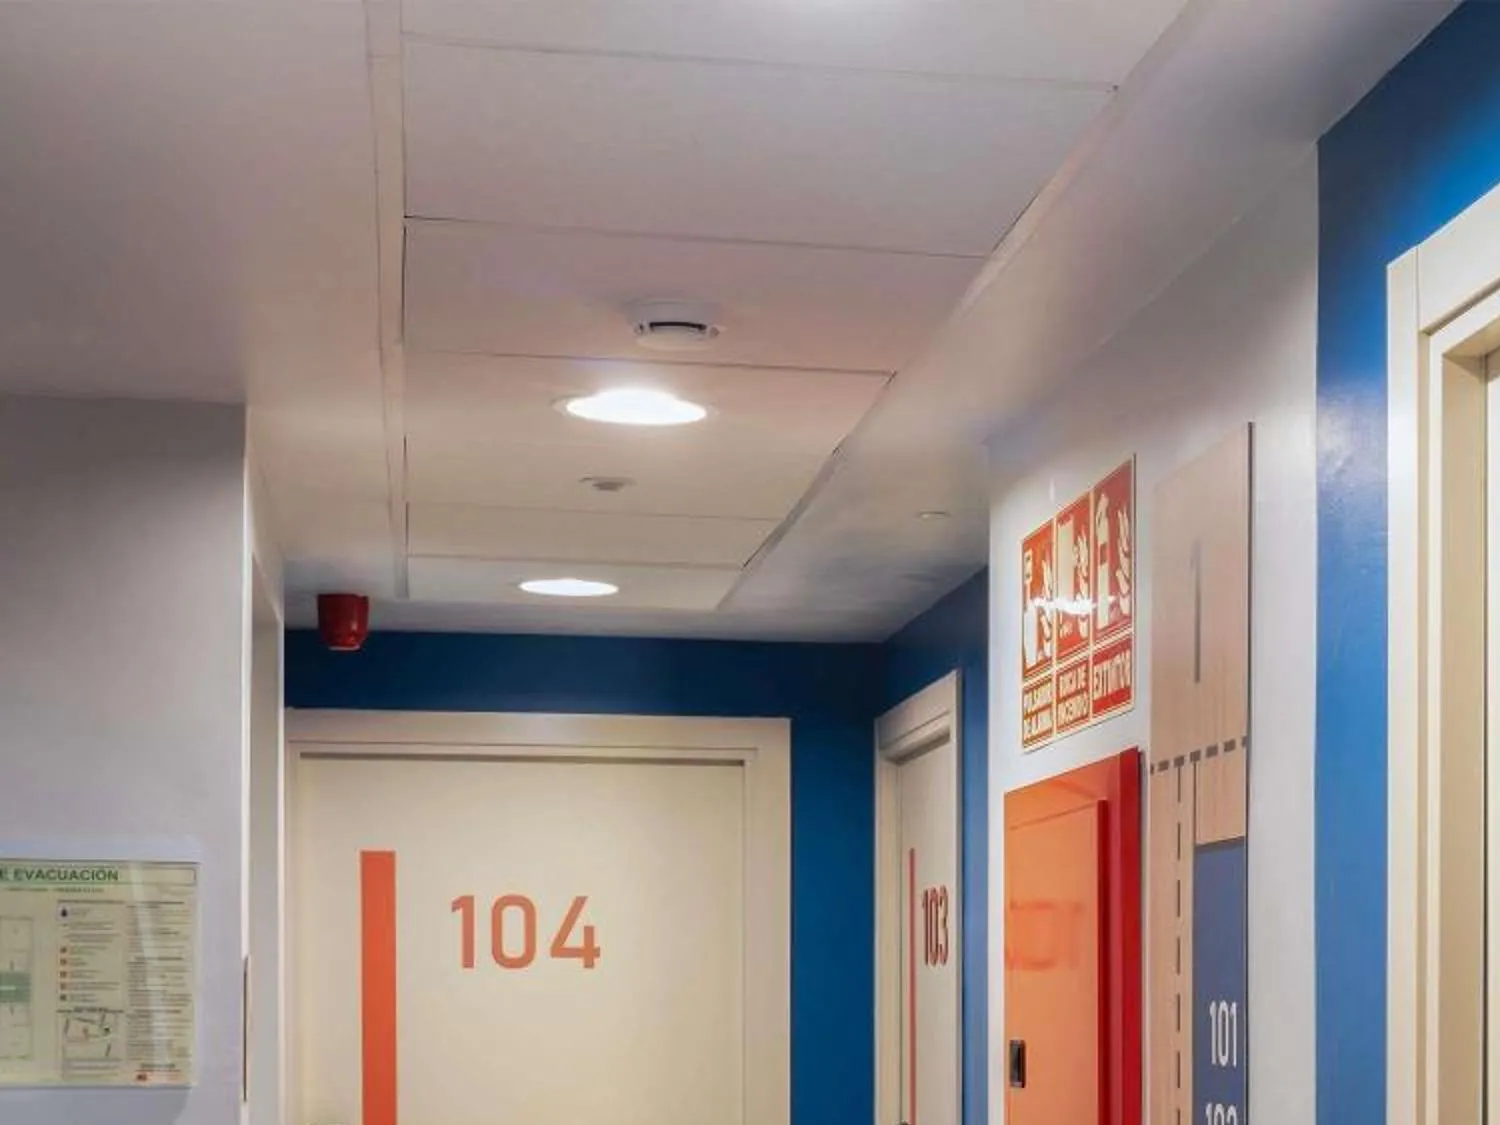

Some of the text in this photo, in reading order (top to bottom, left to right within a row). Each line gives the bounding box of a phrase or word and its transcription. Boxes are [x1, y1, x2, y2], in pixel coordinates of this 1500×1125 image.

[14, 866, 119, 881] EVACUACIÓN
[451, 894, 601, 969] 104
[922, 885, 949, 966] 103
[1210, 1001, 1238, 1068] 101
